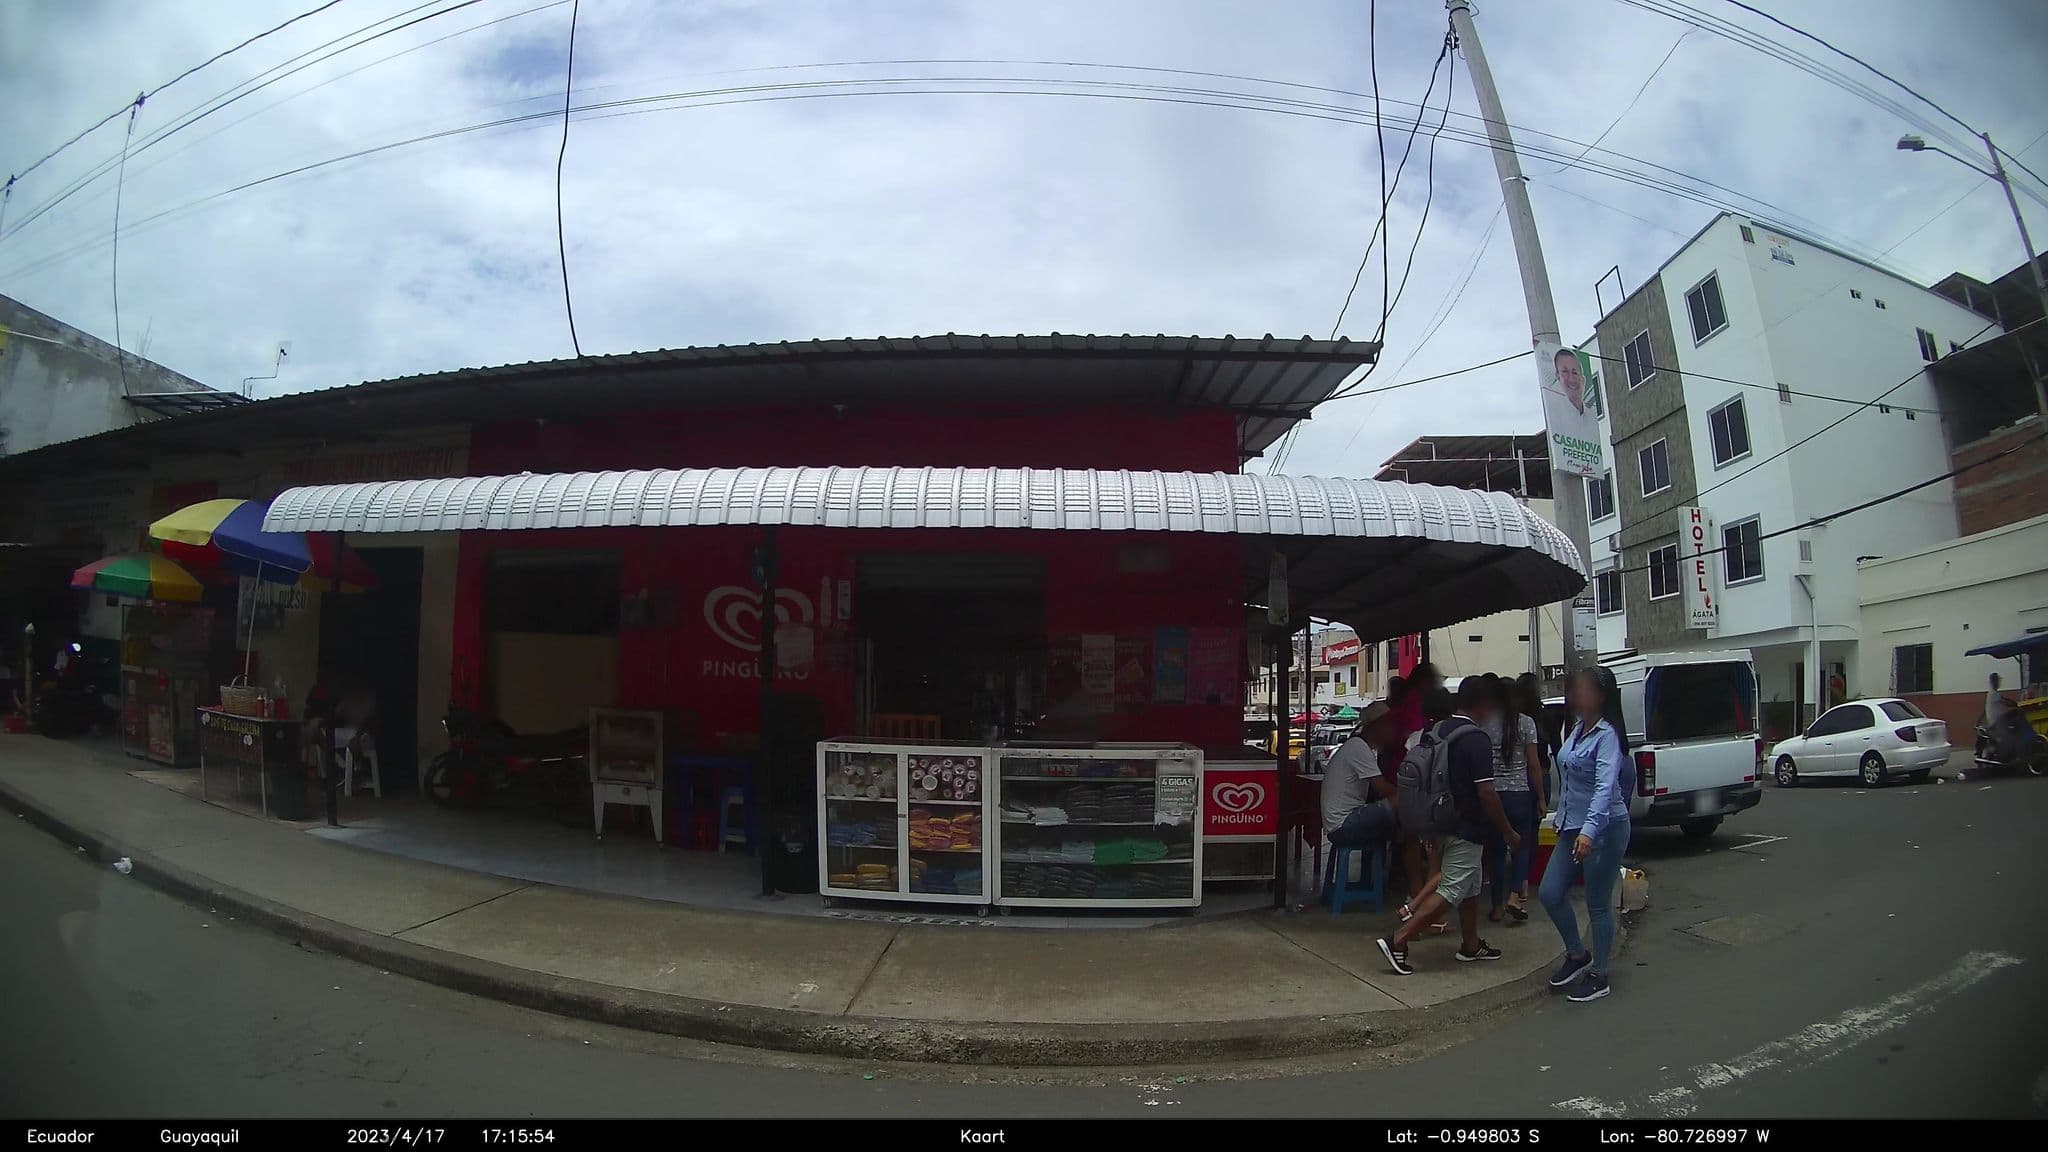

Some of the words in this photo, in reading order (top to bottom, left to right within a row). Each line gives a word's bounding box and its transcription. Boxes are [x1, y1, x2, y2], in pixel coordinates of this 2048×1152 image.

[1552, 433, 1602, 456] CASANOVA
[1562, 447, 1599, 465] PREFECTO
[1690, 508, 1707, 592] HOTEL
[1692, 608, 1714, 619] ÁGATA
[1161, 778, 1168, 786] 4
[1168, 778, 1194, 786] GIGAS
[1211, 812, 1264, 824] PINGÜINO
